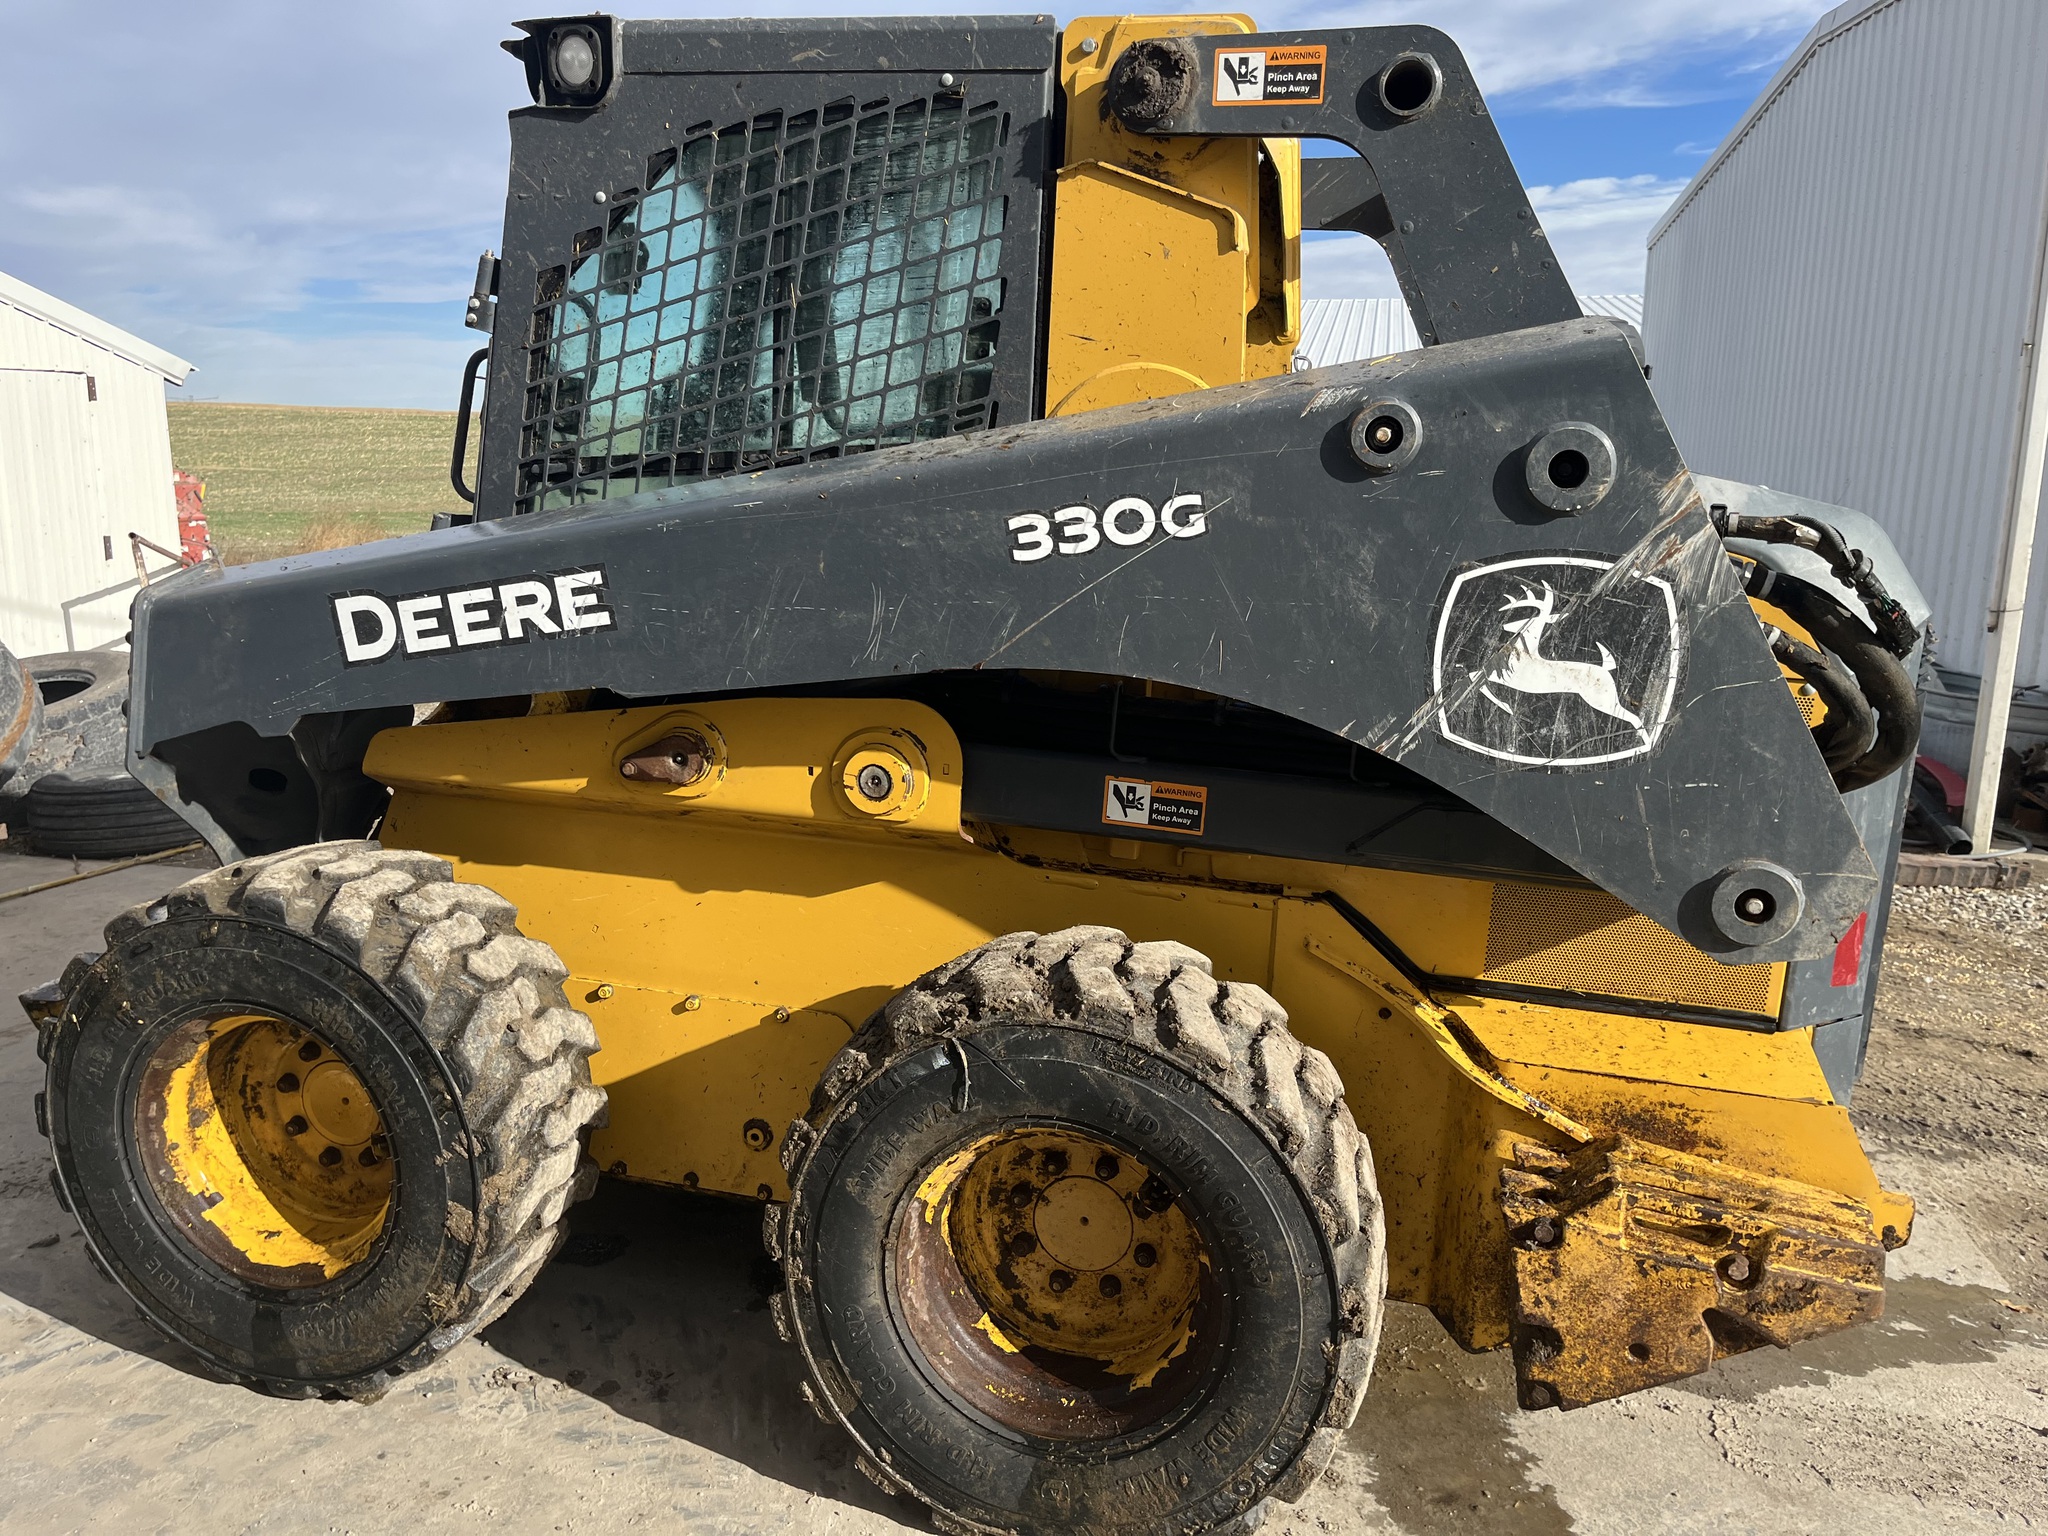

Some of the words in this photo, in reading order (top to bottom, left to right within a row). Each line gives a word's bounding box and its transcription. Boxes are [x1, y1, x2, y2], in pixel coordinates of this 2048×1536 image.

[1279, 51, 1321, 60] WARNING
[1267, 72, 1294, 82] Pinch
[1295, 72, 1318, 81] Area
[1266, 85, 1287, 94] Keep
[1288, 84, 1310, 94] Away
[1007, 494, 1206, 562] 330G
[334, 570, 611, 662] DEERE
[1163, 788, 1202, 799] WARNING
[1153, 802, 1177, 813] Pinch
[1179, 806, 1199, 816] Area
[1152, 813, 1171, 823] Keep
[1171, 816, 1192, 826] Away
[854, 1128, 910, 1194] WIDE
[1165, 1132, 1220, 1186] RIM
[840, 1303, 900, 1401] GUARD
